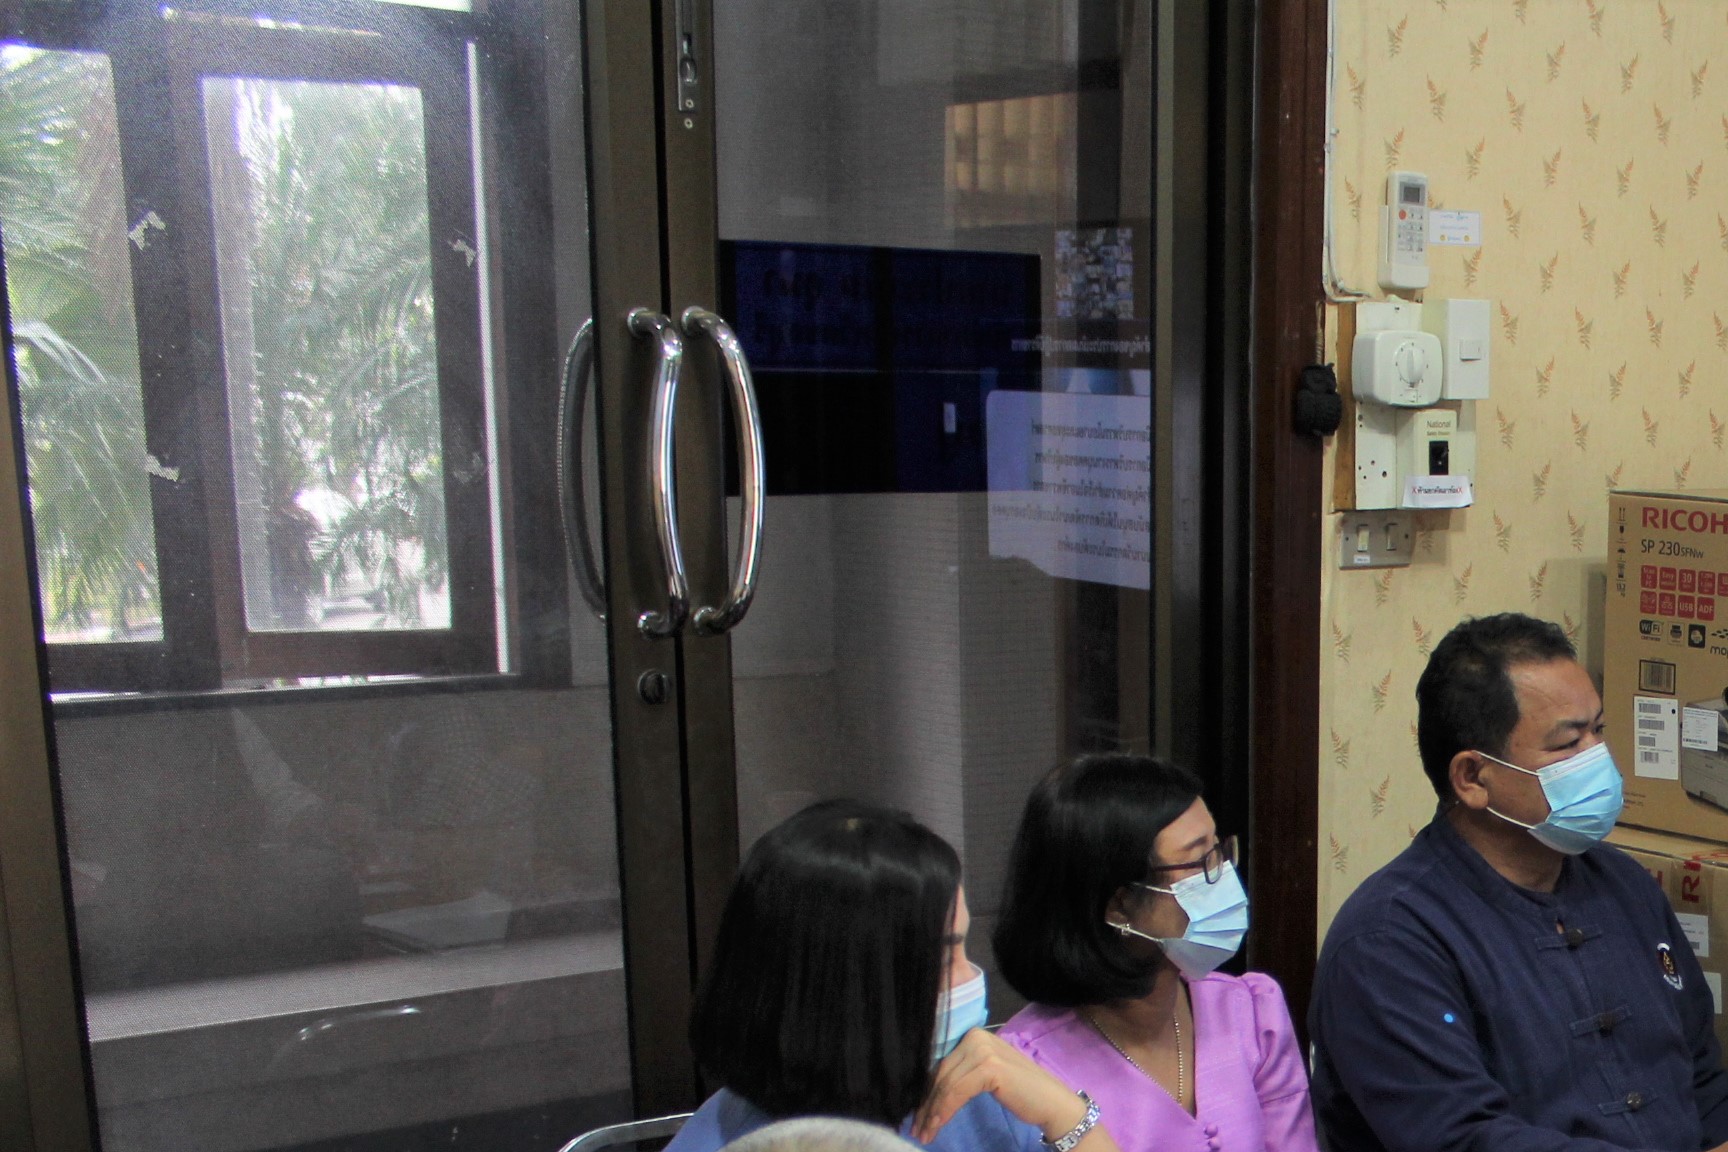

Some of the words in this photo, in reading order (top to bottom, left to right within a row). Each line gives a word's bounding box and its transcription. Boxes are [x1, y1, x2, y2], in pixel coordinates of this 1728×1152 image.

[1426, 420, 1451, 429] National
[1642, 506, 1728, 535] RICOH
[1641, 539, 1655, 554] SP
[1682, 573, 1692, 583] 30
[1679, 602, 1694, 612] USB
[1698, 604, 1714, 614] ADF
